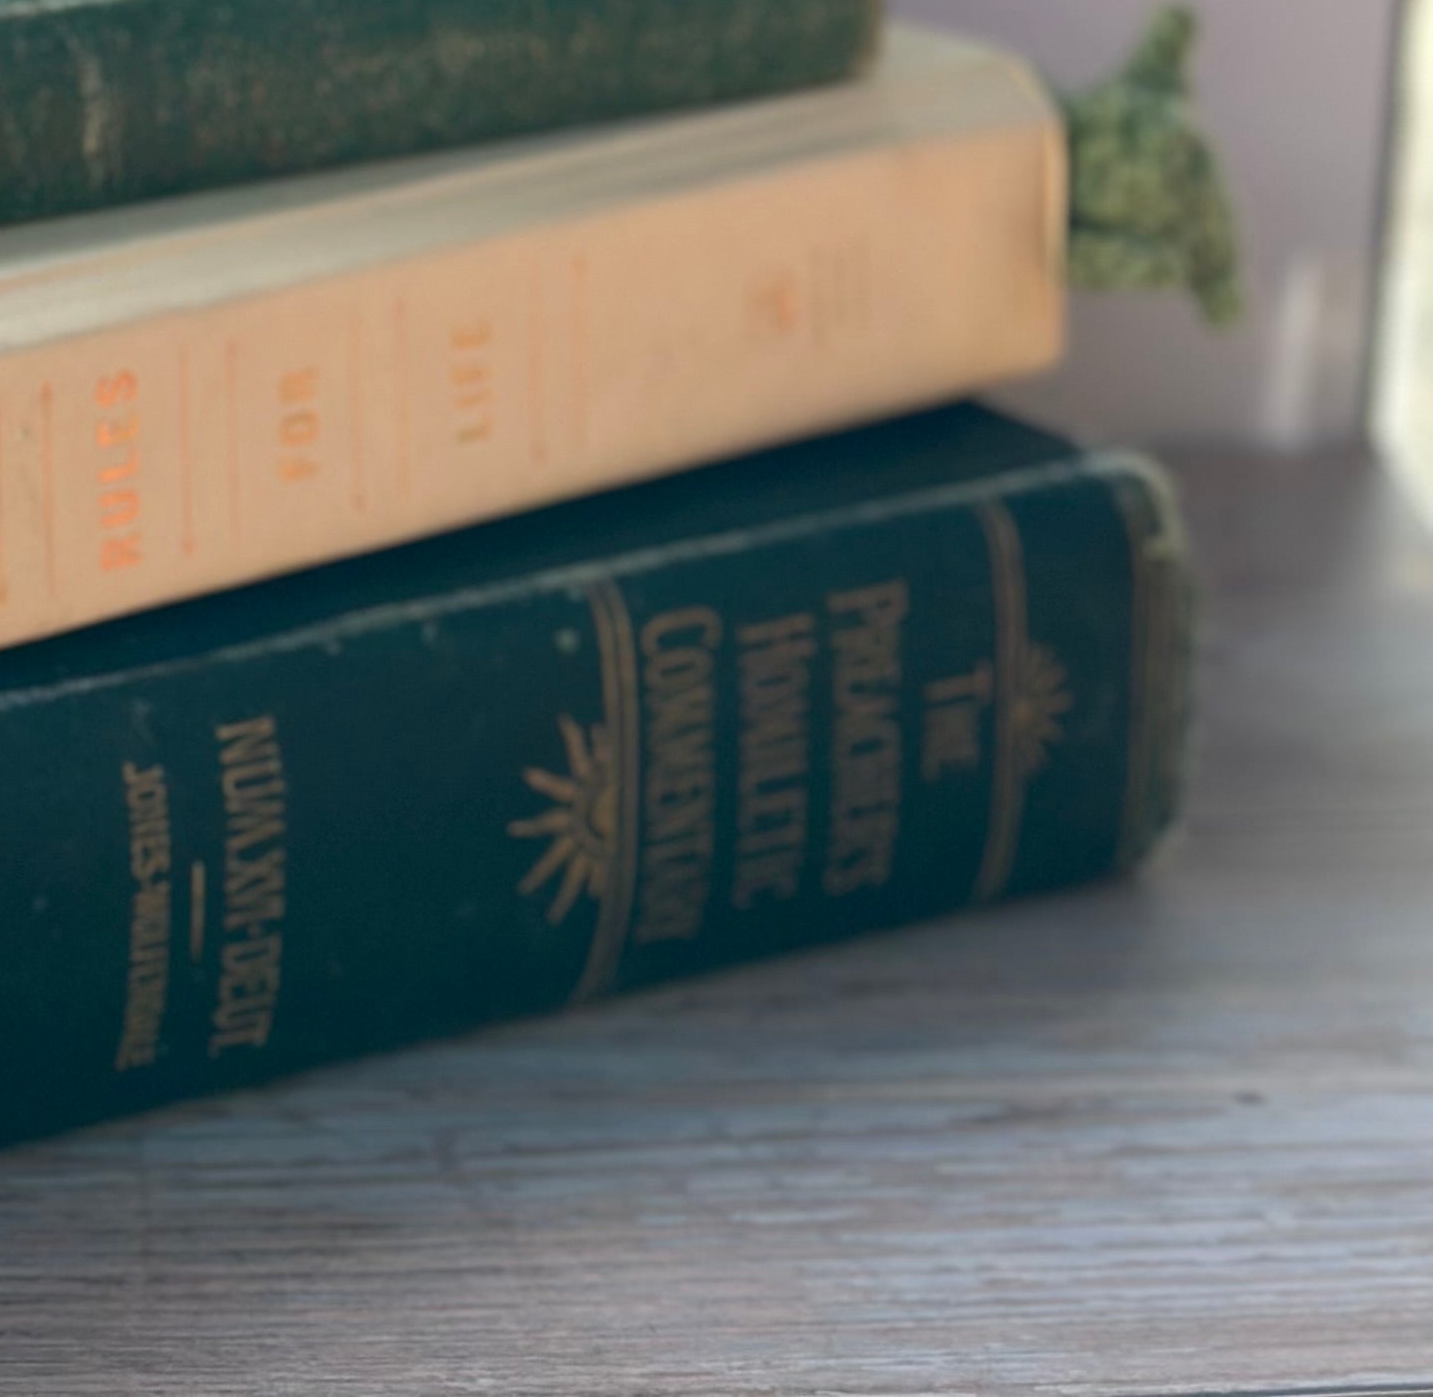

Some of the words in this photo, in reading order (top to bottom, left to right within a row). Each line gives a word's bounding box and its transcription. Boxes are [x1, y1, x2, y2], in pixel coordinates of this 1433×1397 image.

[278, 366, 319, 483] FOR
[450, 320, 491, 444] LIFE
[95, 369, 141, 571] RULES
